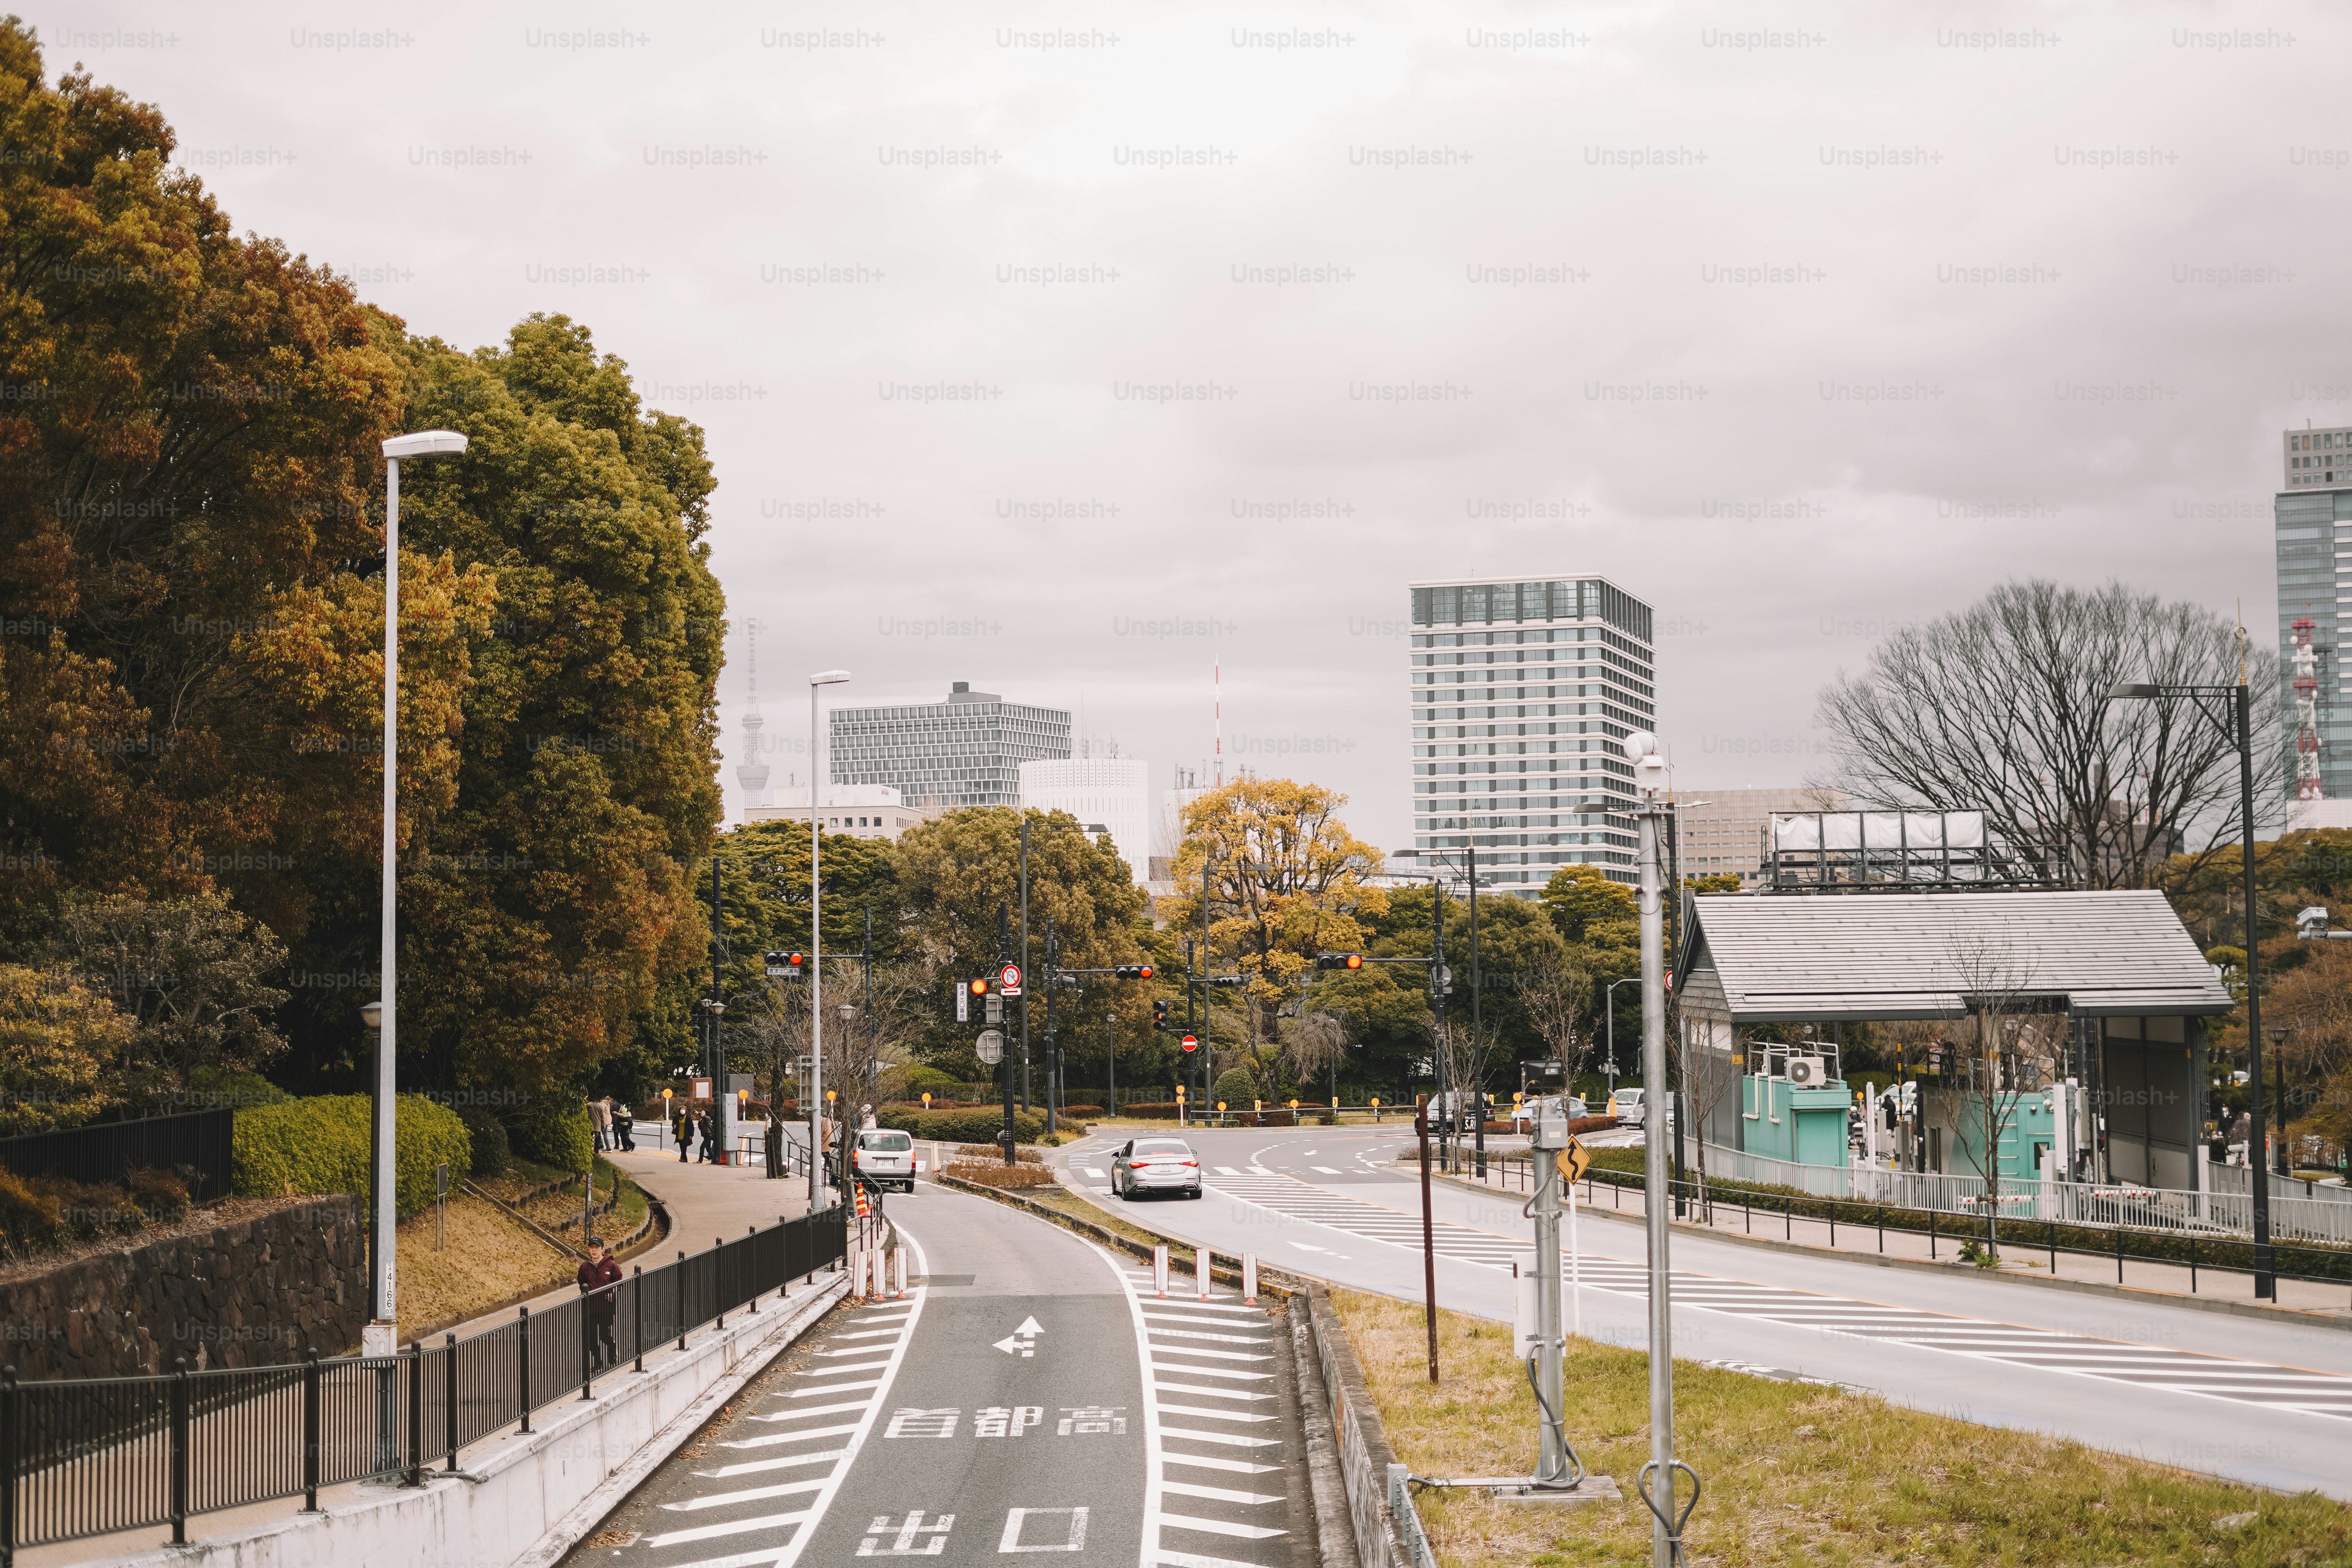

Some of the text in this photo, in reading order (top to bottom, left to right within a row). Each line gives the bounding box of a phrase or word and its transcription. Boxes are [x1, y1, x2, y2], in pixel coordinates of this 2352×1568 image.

[883, 1406, 1127, 1438] 首都高
[855, 1506, 1089, 1556] 出口
